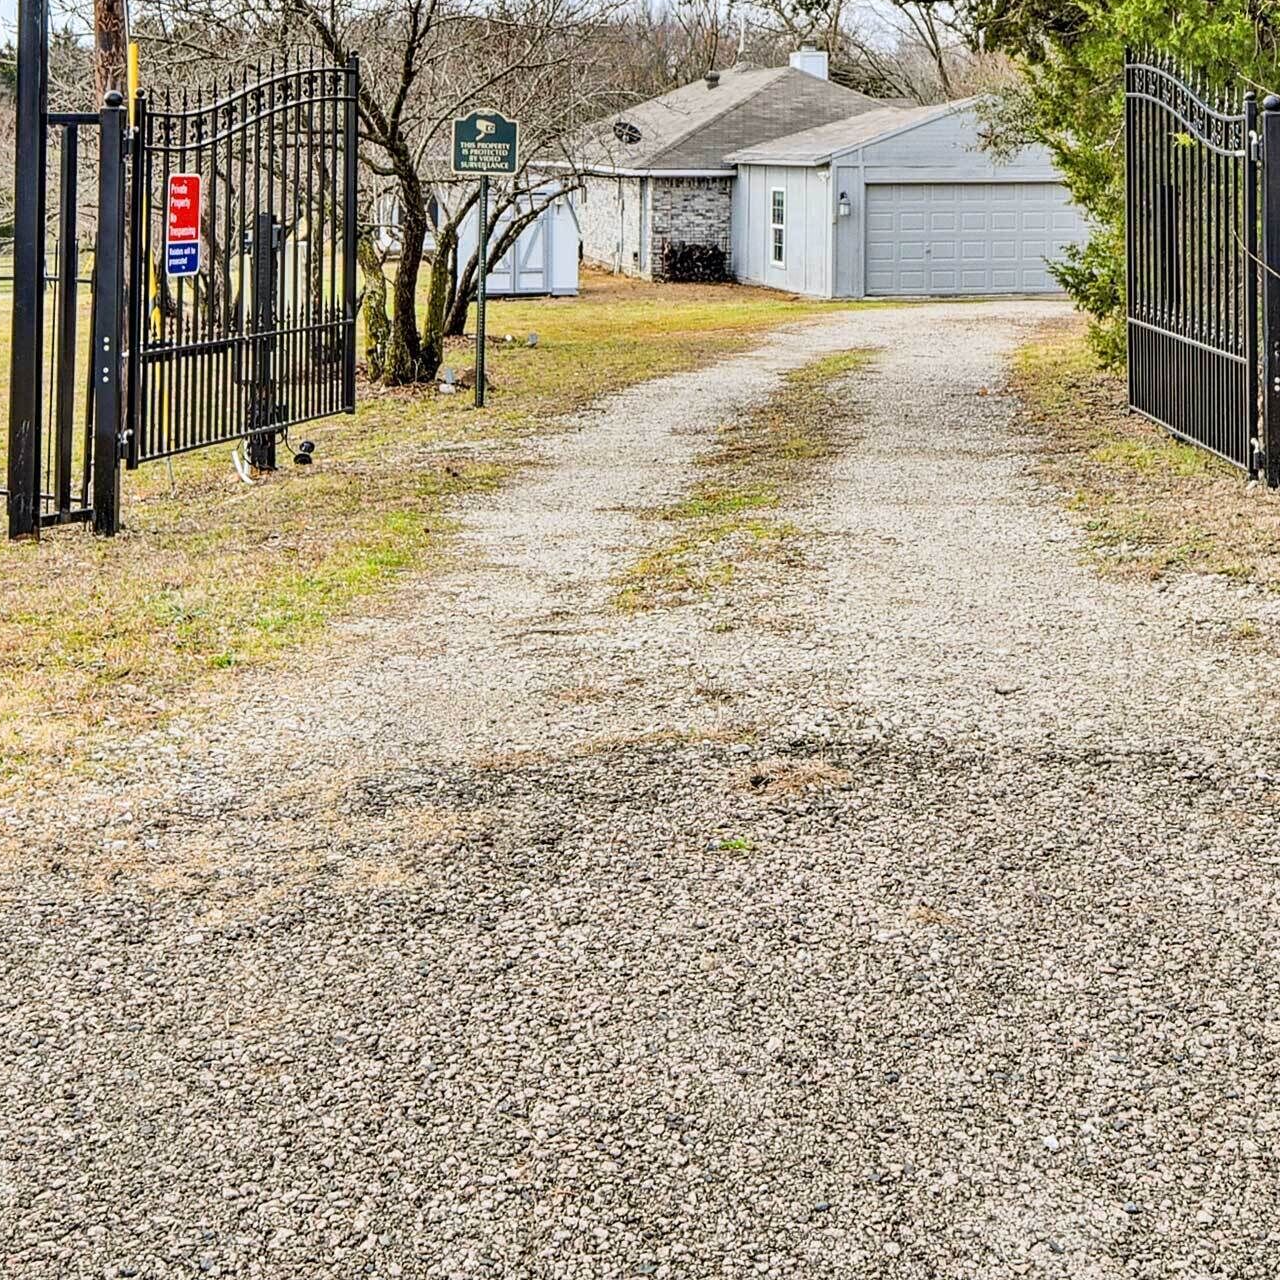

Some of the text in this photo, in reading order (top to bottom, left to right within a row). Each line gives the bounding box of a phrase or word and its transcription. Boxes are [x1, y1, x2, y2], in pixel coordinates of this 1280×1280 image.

[476, 142, 511, 150] PROPERTY
[460, 161, 509, 169] SURVEILLANCE
[171, 183, 188, 195] Private
[171, 197, 191, 209] Property
[170, 225, 196, 238] Trespassing
